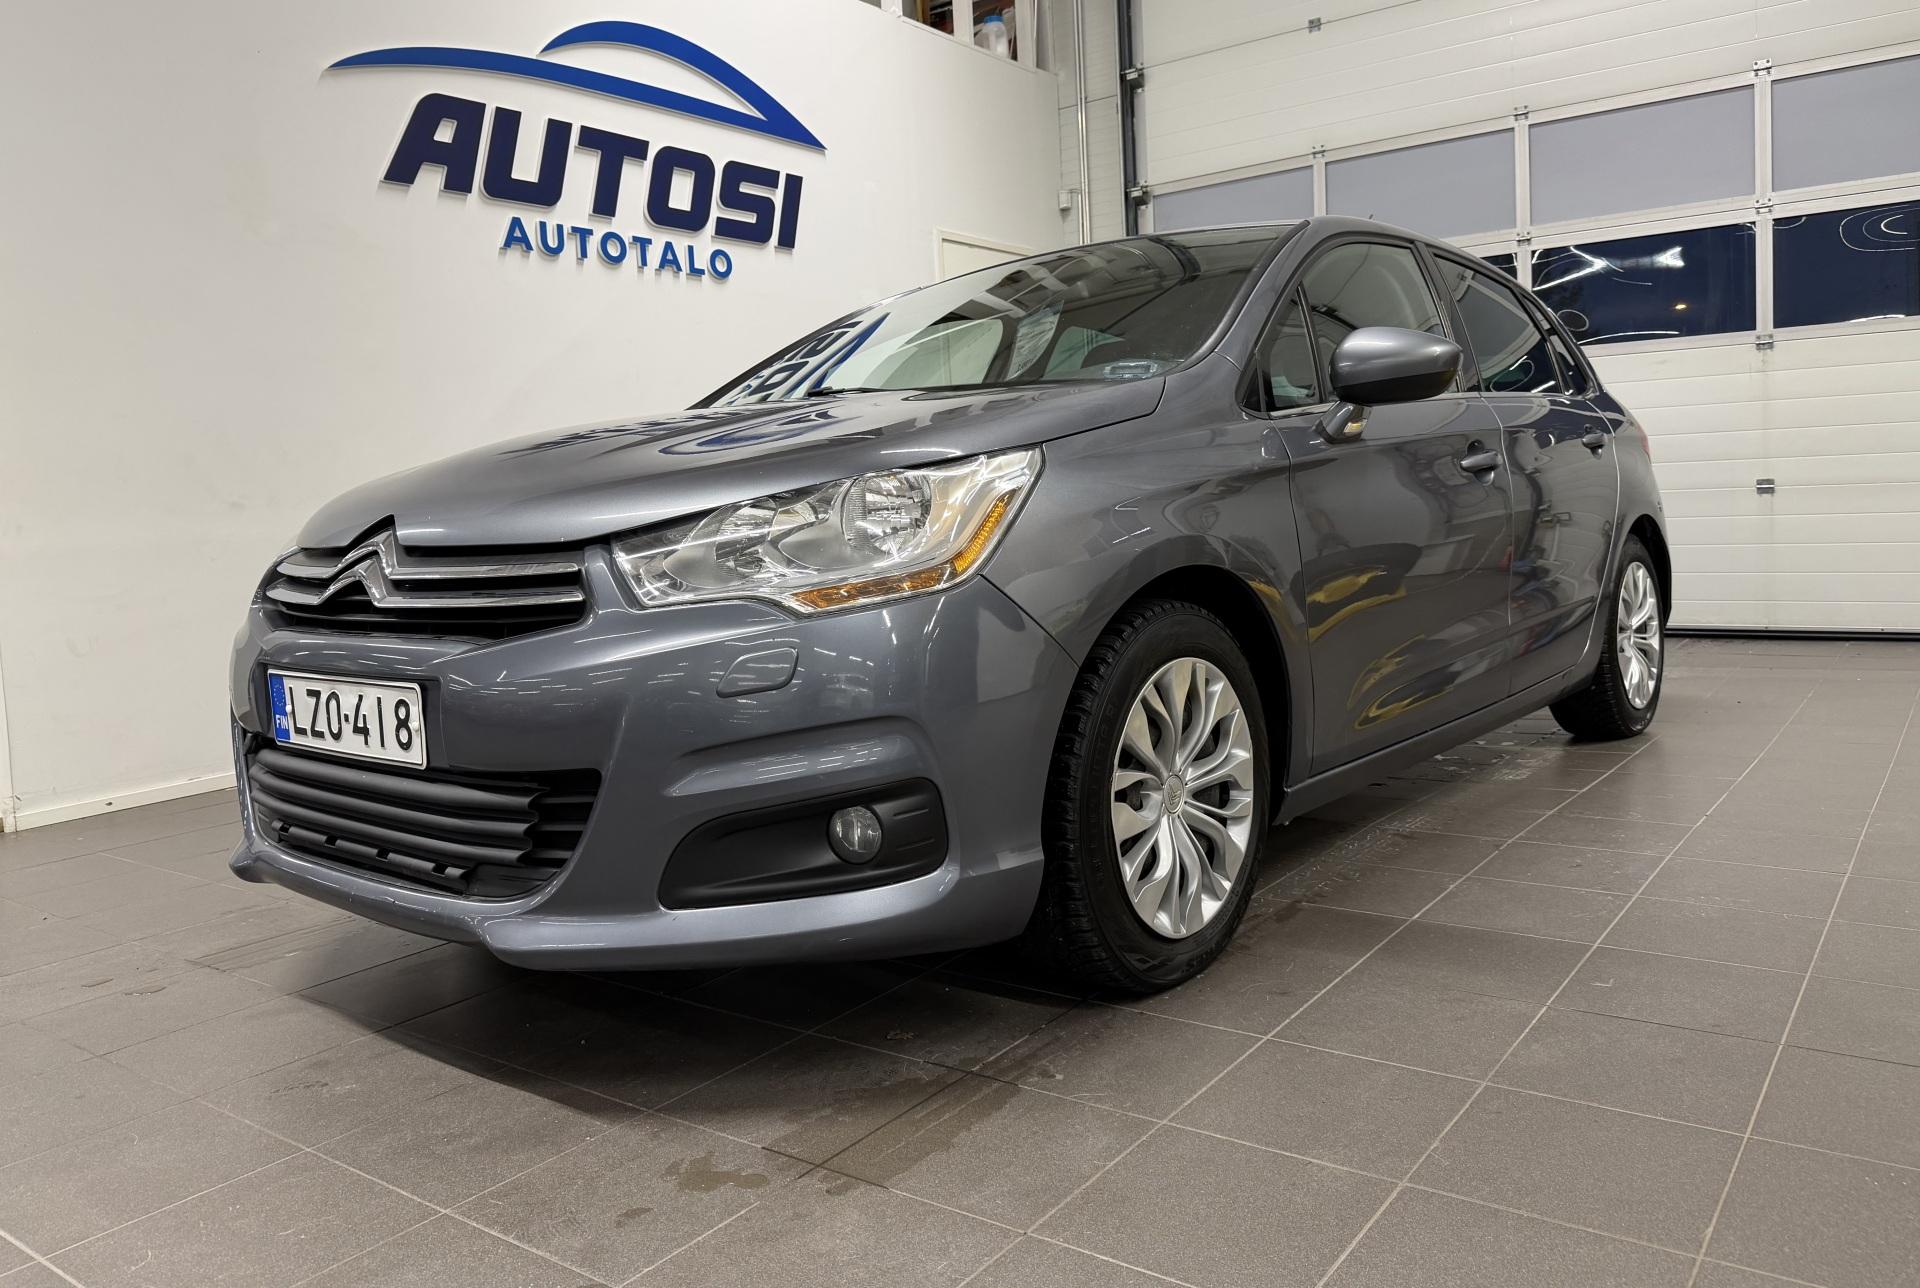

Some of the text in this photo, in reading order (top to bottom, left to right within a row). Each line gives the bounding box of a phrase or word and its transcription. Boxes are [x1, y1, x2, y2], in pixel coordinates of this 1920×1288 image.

[382, 93, 803, 249] AUTOSI
[501, 216, 733, 280] AUTOTALO
[275, 714, 289, 730] FIN
[288, 686, 413, 750] LZO-418
